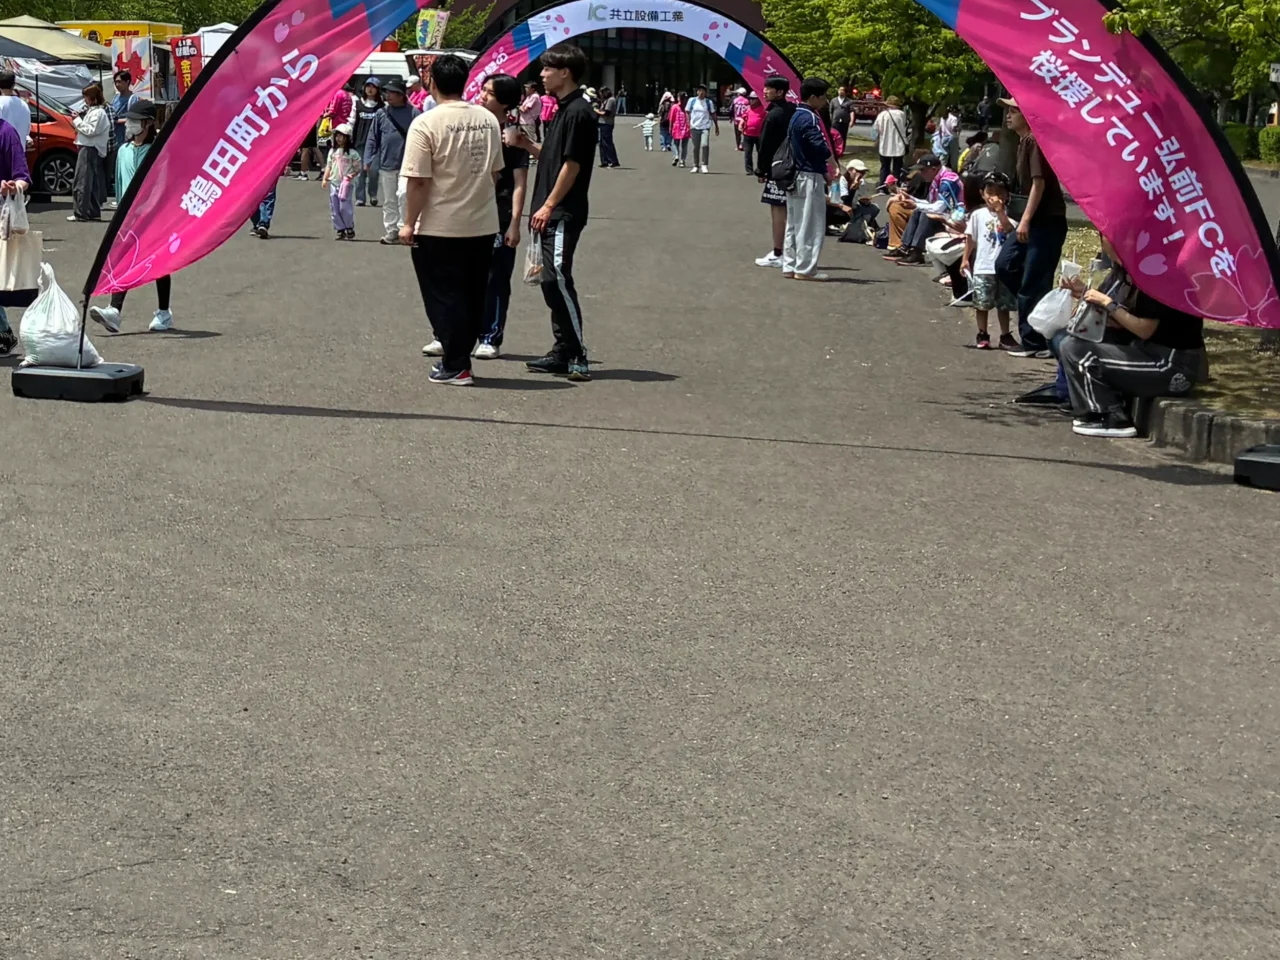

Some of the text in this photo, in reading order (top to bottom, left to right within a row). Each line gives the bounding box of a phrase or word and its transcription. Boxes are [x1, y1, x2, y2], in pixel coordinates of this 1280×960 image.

[609, 8, 685, 22] 共立設備工業
[180, 48, 319, 218] 鶴田町から
[1028, 49, 1186, 245] 桜援しています!
